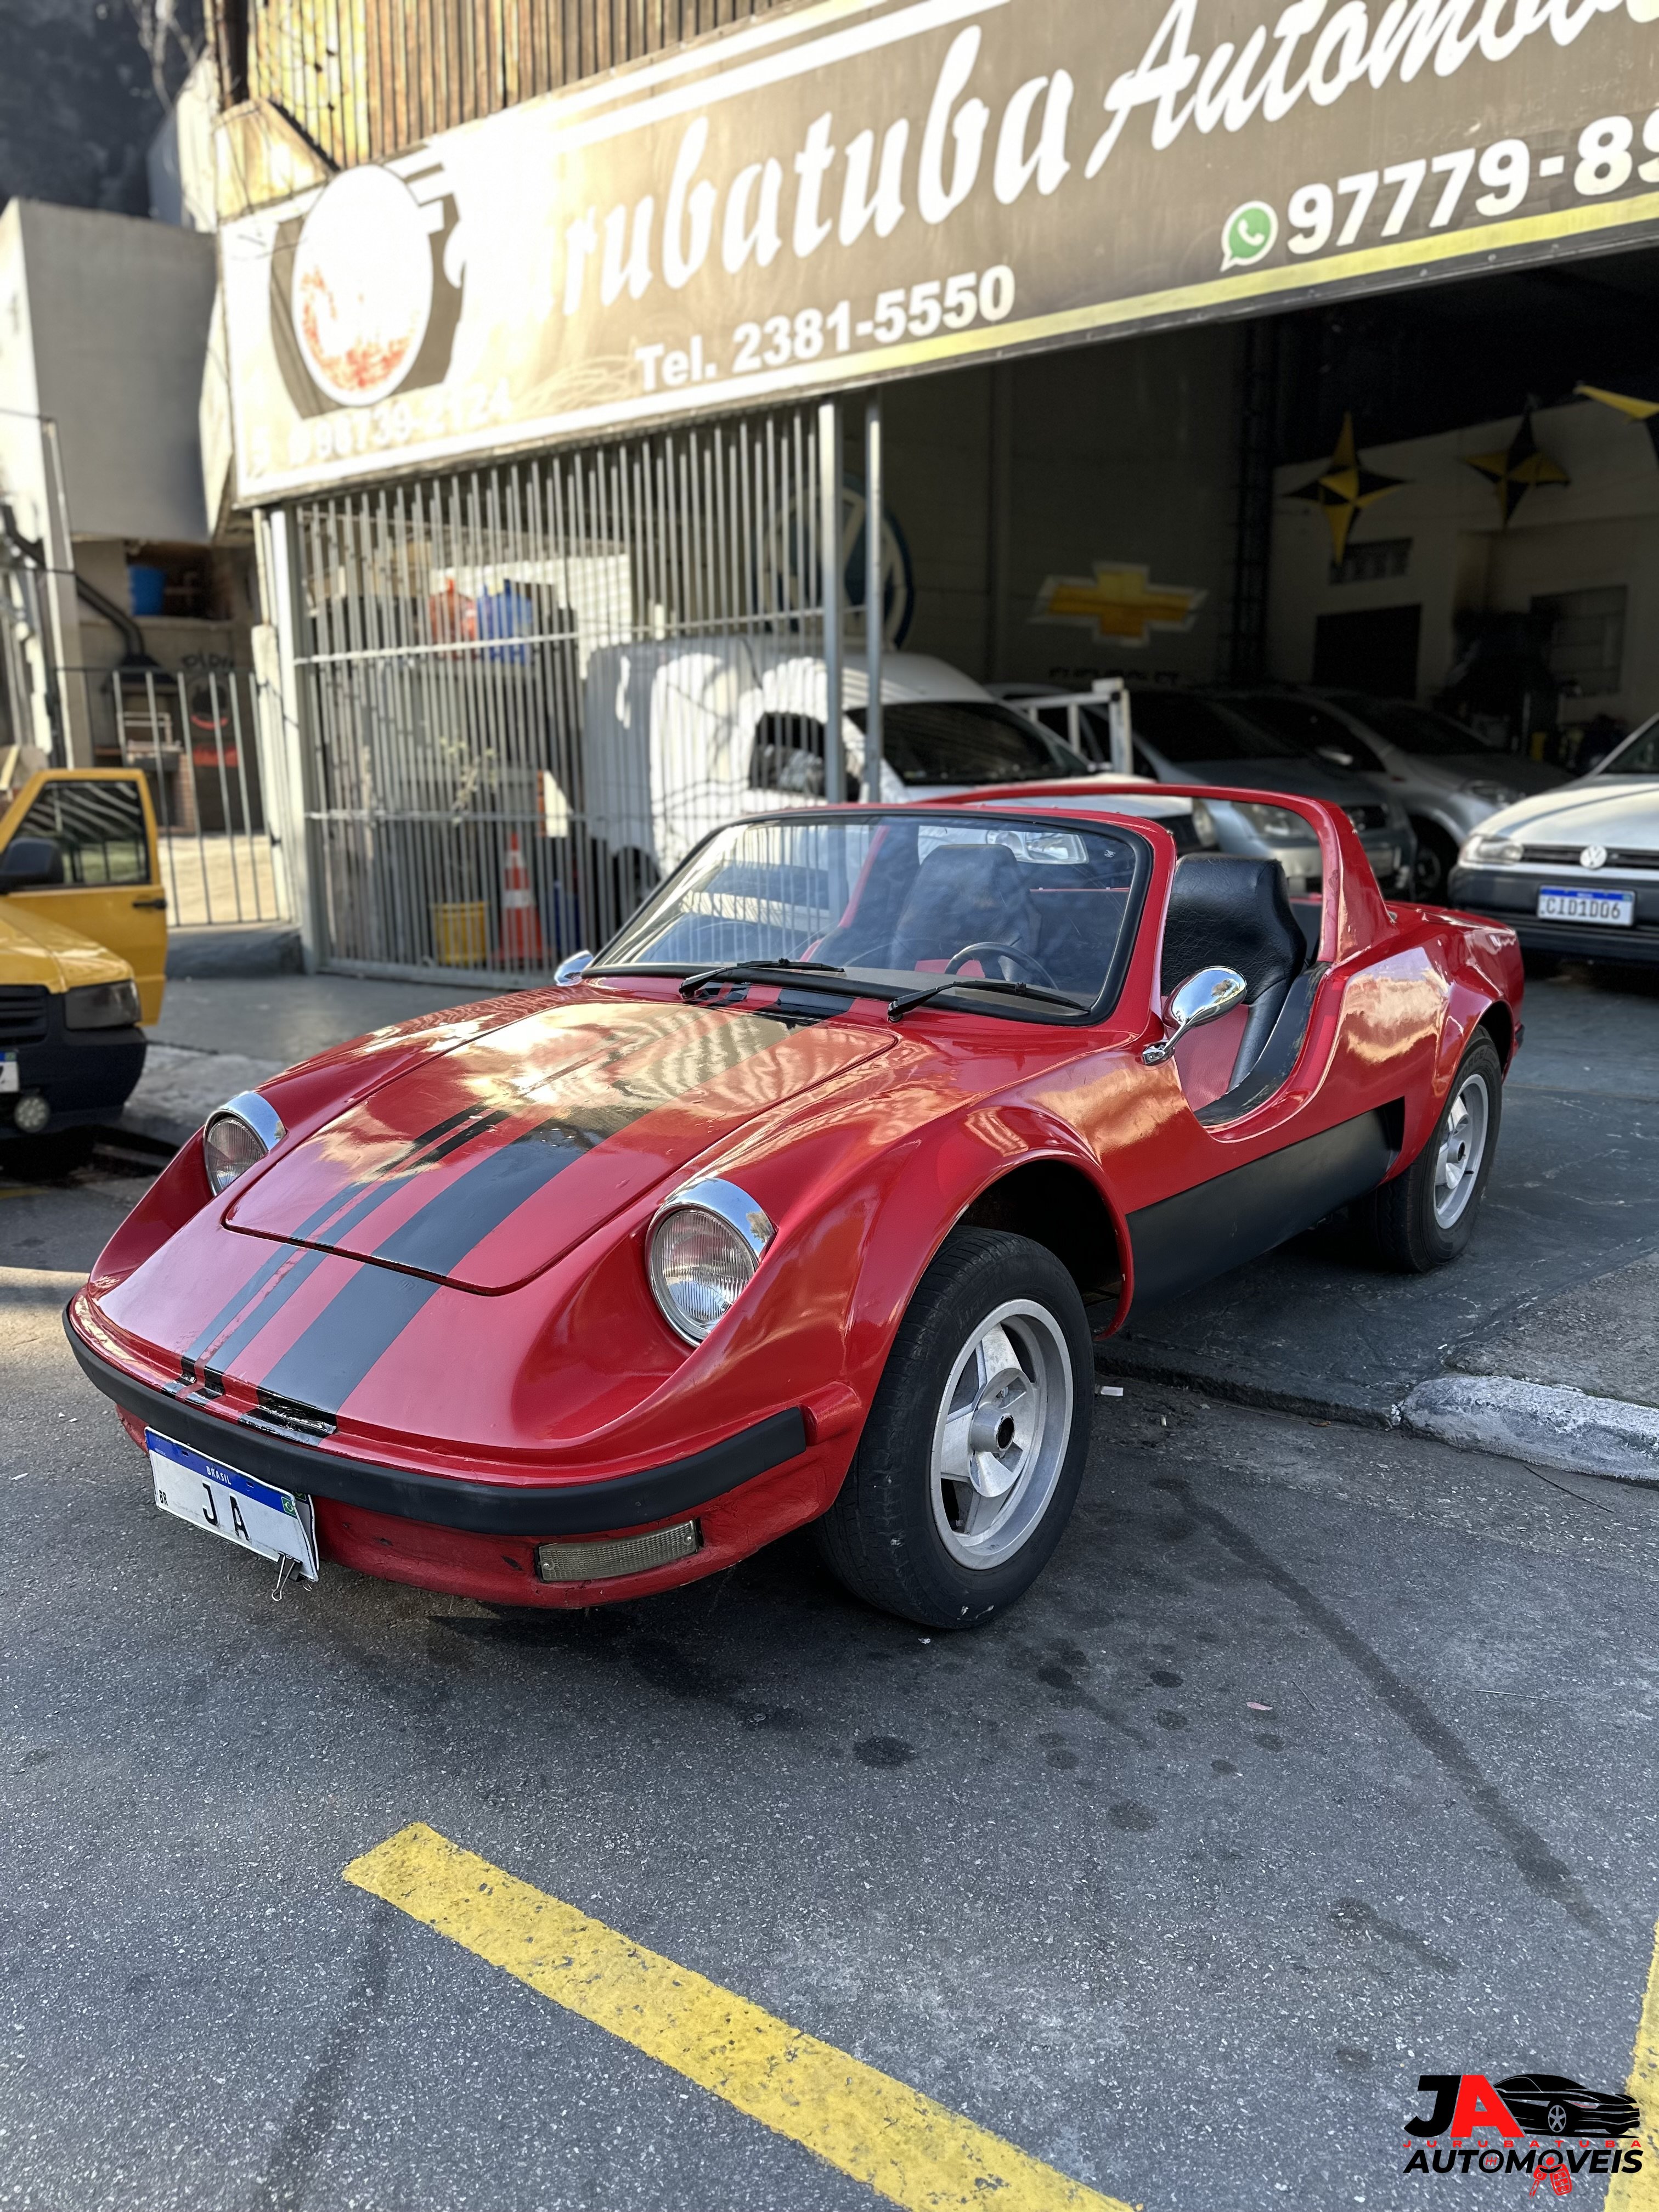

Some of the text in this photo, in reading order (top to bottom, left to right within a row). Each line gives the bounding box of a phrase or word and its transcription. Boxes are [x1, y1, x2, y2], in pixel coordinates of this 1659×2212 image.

[635, 264, 1015, 392] Tel. 2381-5550
[206, 1465, 232, 1485] BRASIL
[159, 1490, 168, 1505] BR
[202, 1482, 249, 1541] J A
